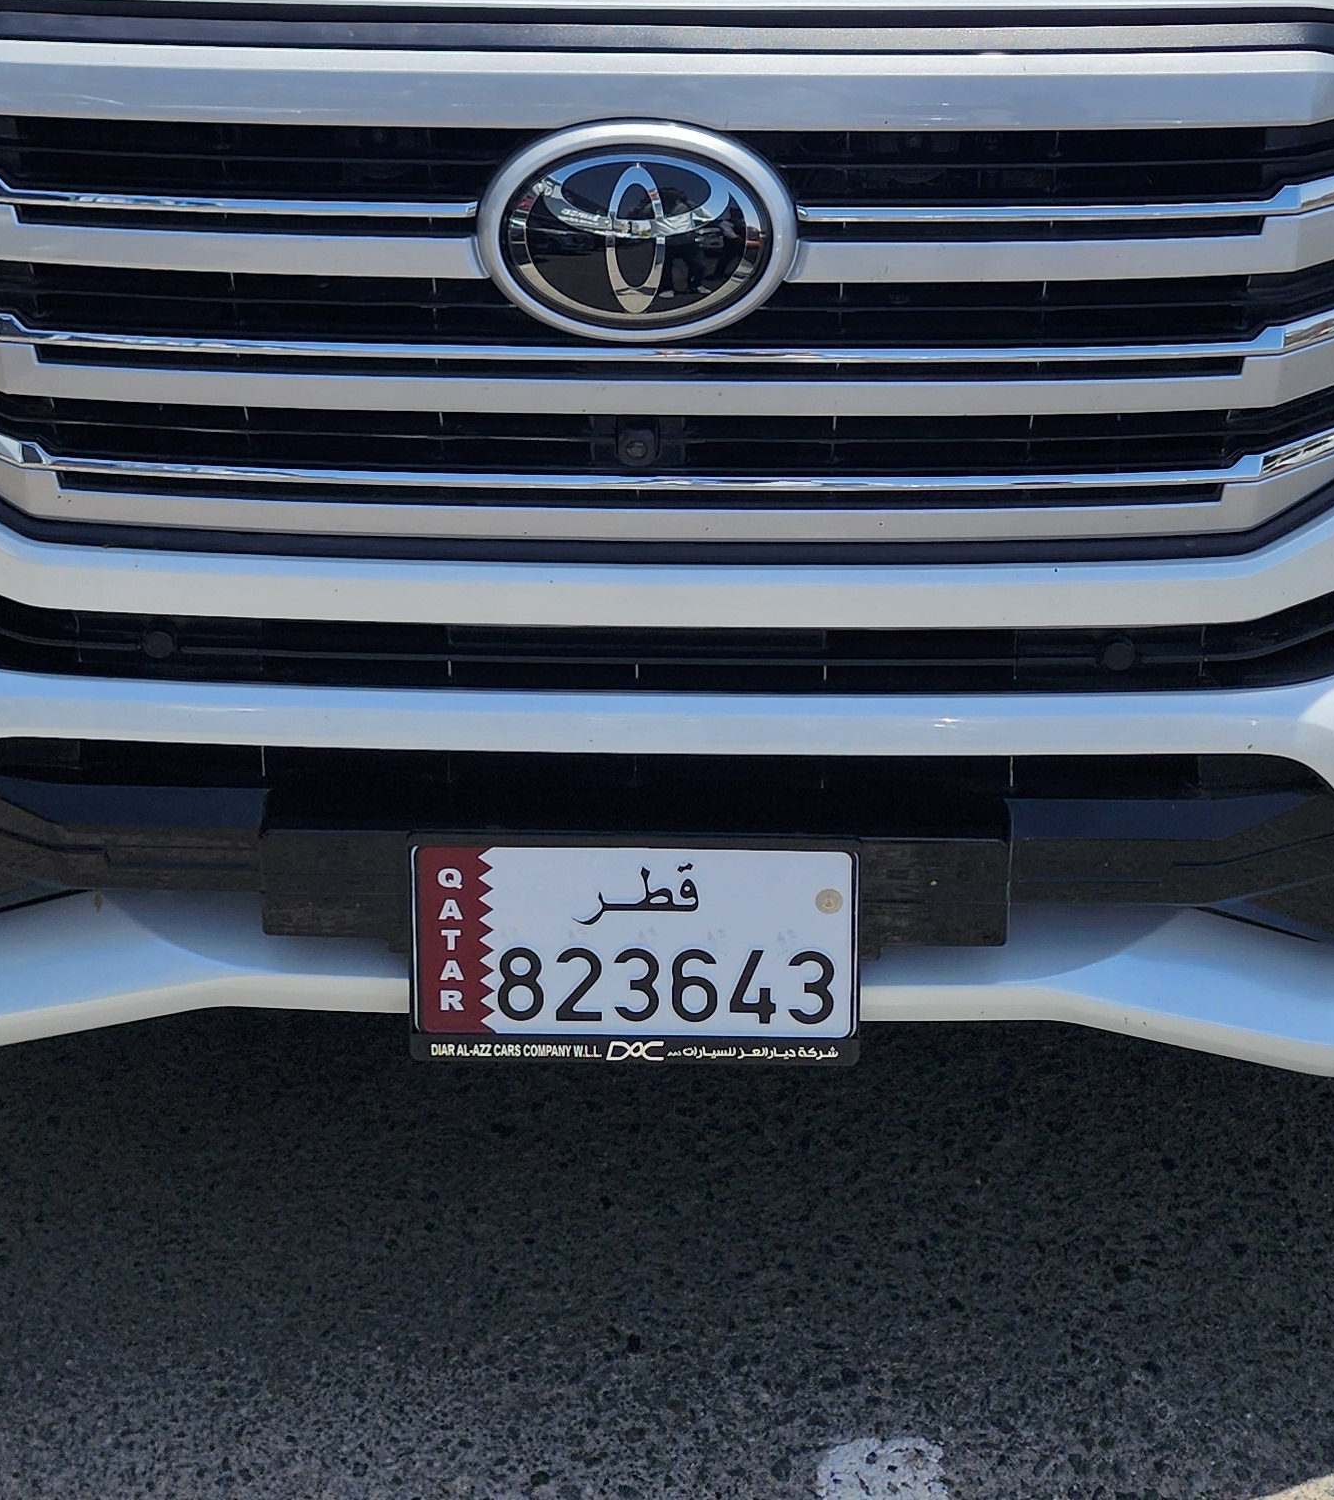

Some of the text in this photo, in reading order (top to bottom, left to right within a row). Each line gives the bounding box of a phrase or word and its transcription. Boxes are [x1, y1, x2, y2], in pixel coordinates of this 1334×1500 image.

[572, 862, 700, 926] قطر
[437, 867, 465, 1012] QATAR
[497, 947, 836, 1025] 823643
[430, 1043, 456, 1057] DIAR
[456, 1043, 492, 1057] AL-AZZ
[493, 1043, 521, 1057] CARS
[523, 1043, 572, 1057] COMPANY
[682, 1046, 737, 1060] للسيارات
[798, 1045, 839, 1061] شركة
